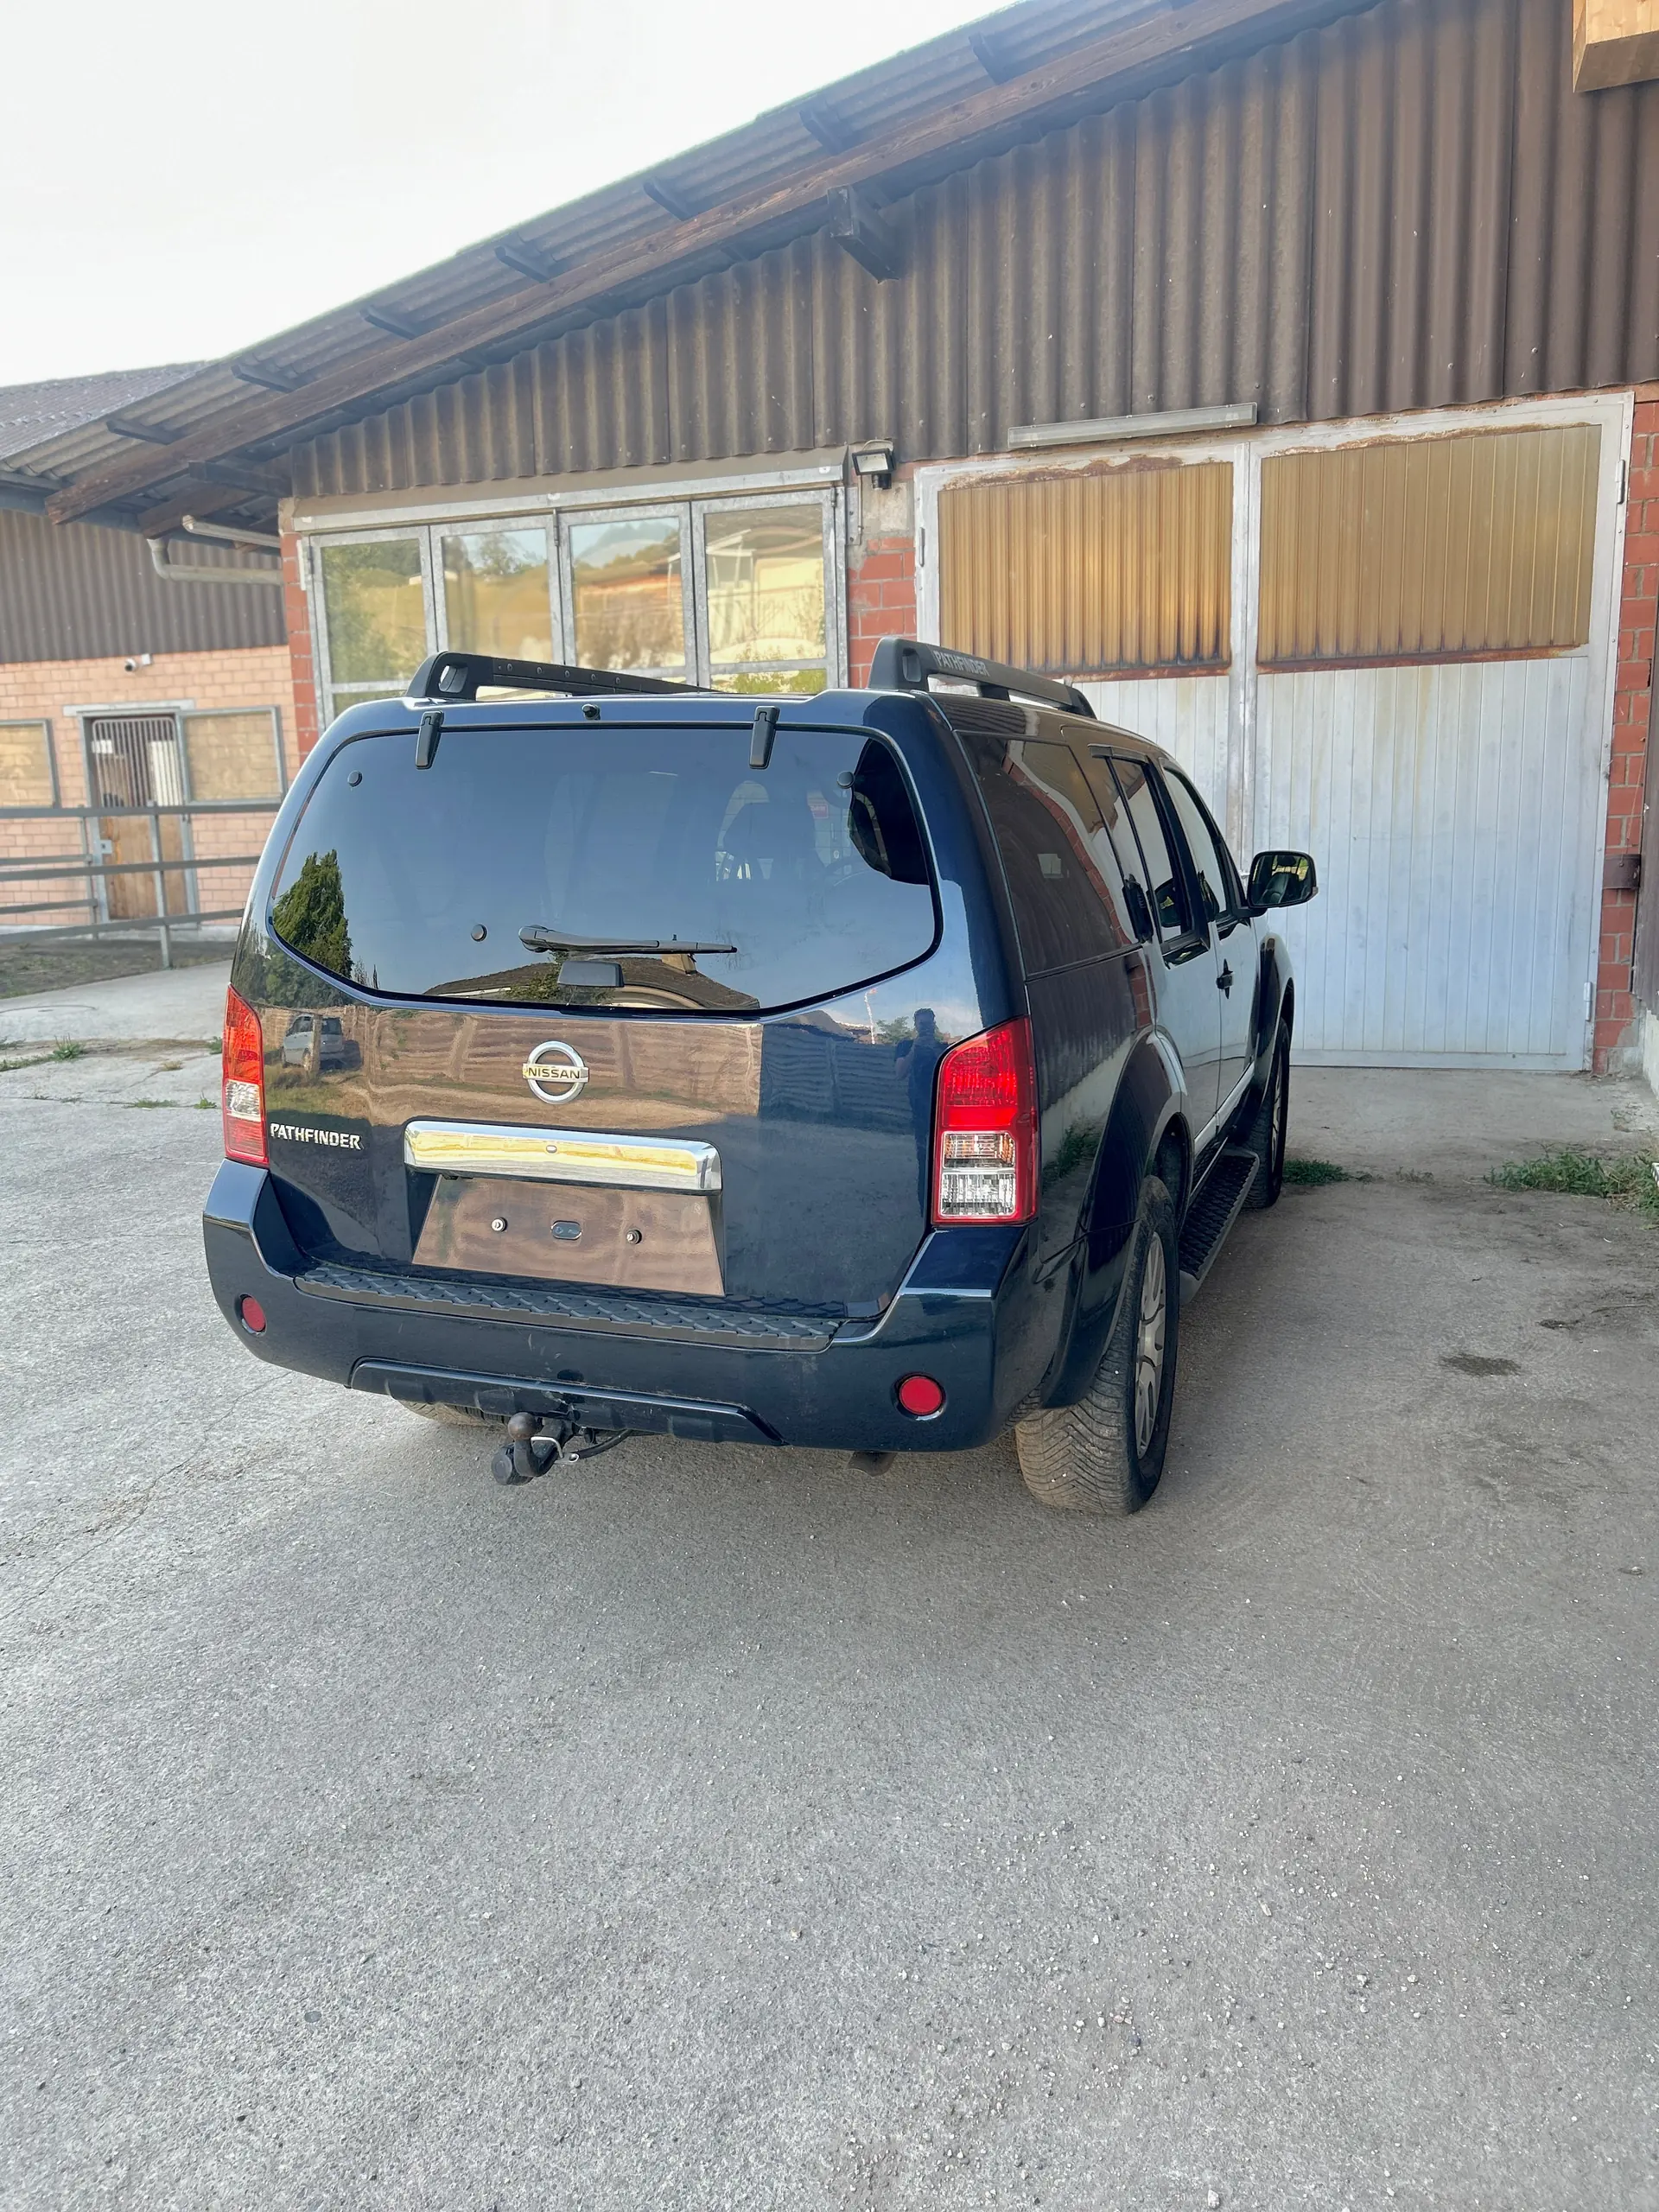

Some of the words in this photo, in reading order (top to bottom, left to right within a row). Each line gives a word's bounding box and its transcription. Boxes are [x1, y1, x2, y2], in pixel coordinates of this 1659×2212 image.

[933, 650, 990, 677] PATHFINDER
[528, 1067, 581, 1079] NISSAN
[270, 1122, 362, 1150] PATHFINDER
